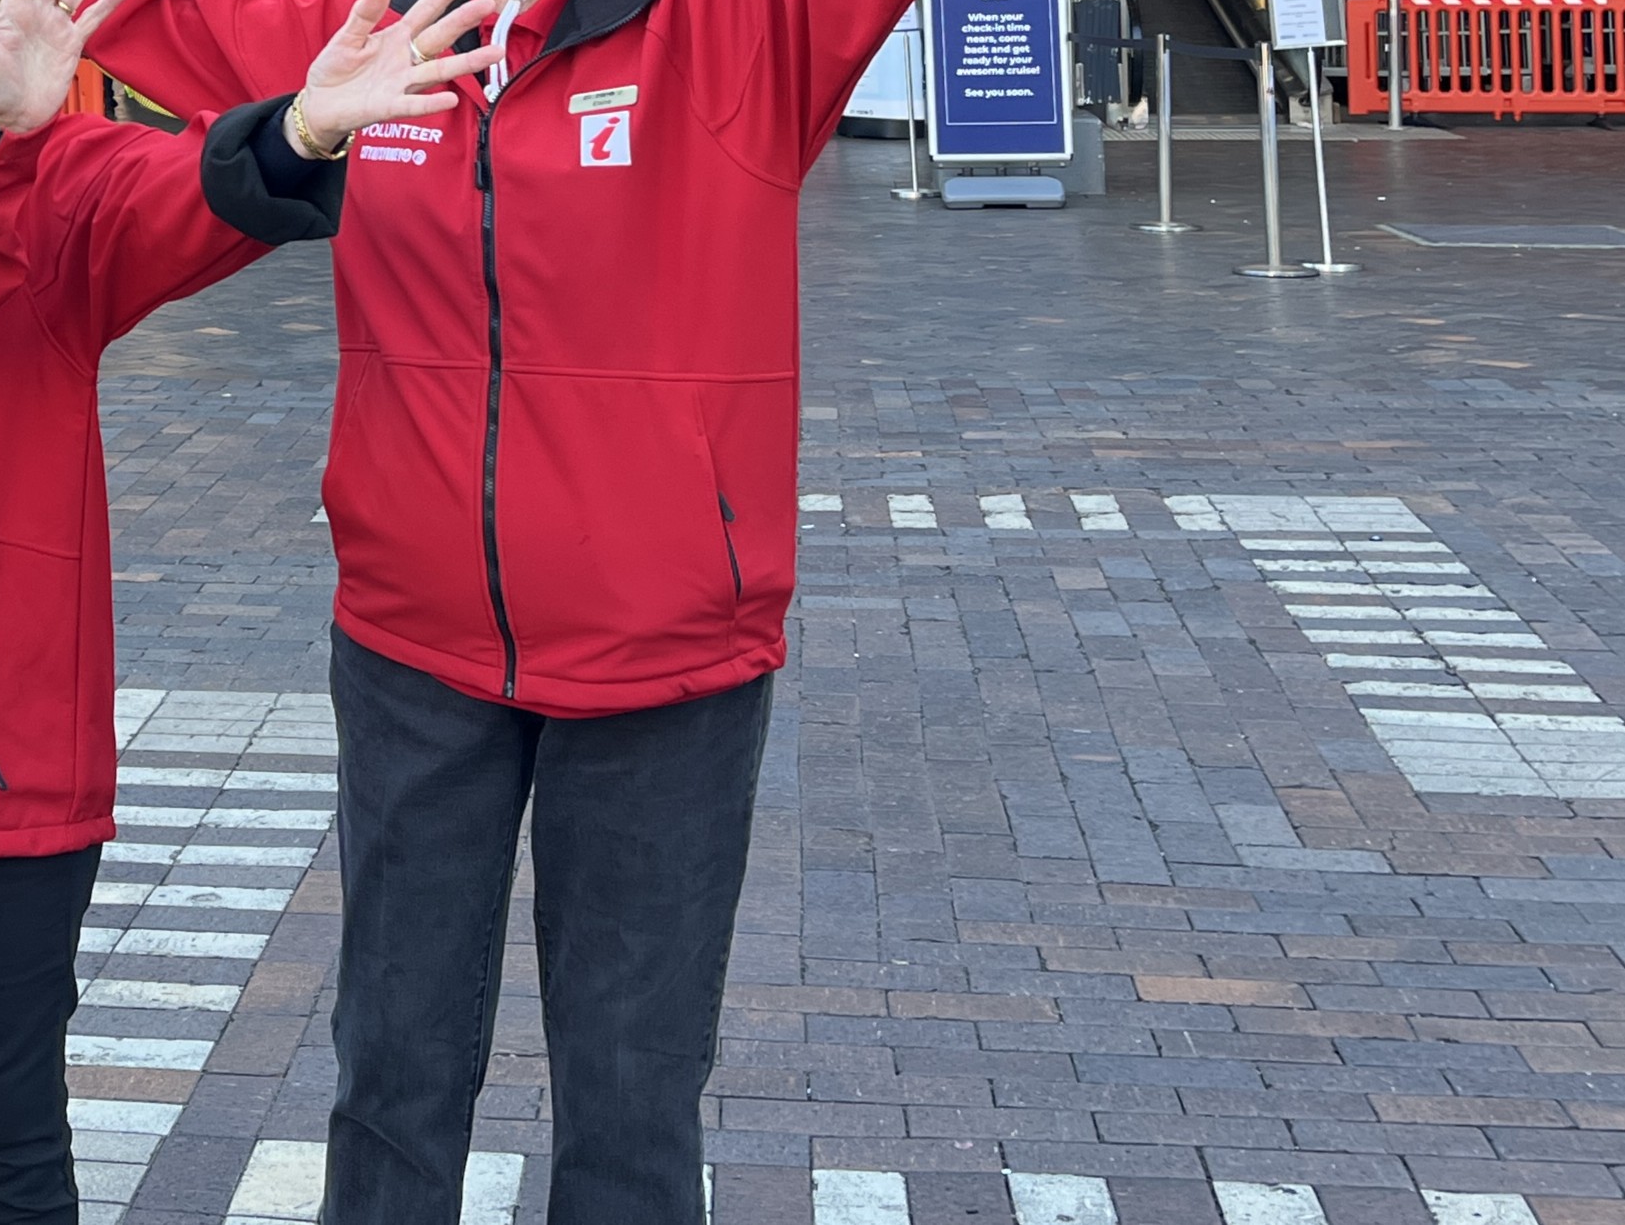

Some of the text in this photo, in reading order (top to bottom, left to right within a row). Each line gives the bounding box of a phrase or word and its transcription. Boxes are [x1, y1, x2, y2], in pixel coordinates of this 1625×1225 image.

[968, 13, 1024, 23] When your
[961, 23, 1031, 33] check-in time
[966, 35, 1027, 44] nears, come
[964, 45, 1030, 55] back and get
[963, 56, 1033, 66] ready for your
[956, 66, 1041, 76] awesome cruise!
[964, 88, 1034, 99] See you soon.
